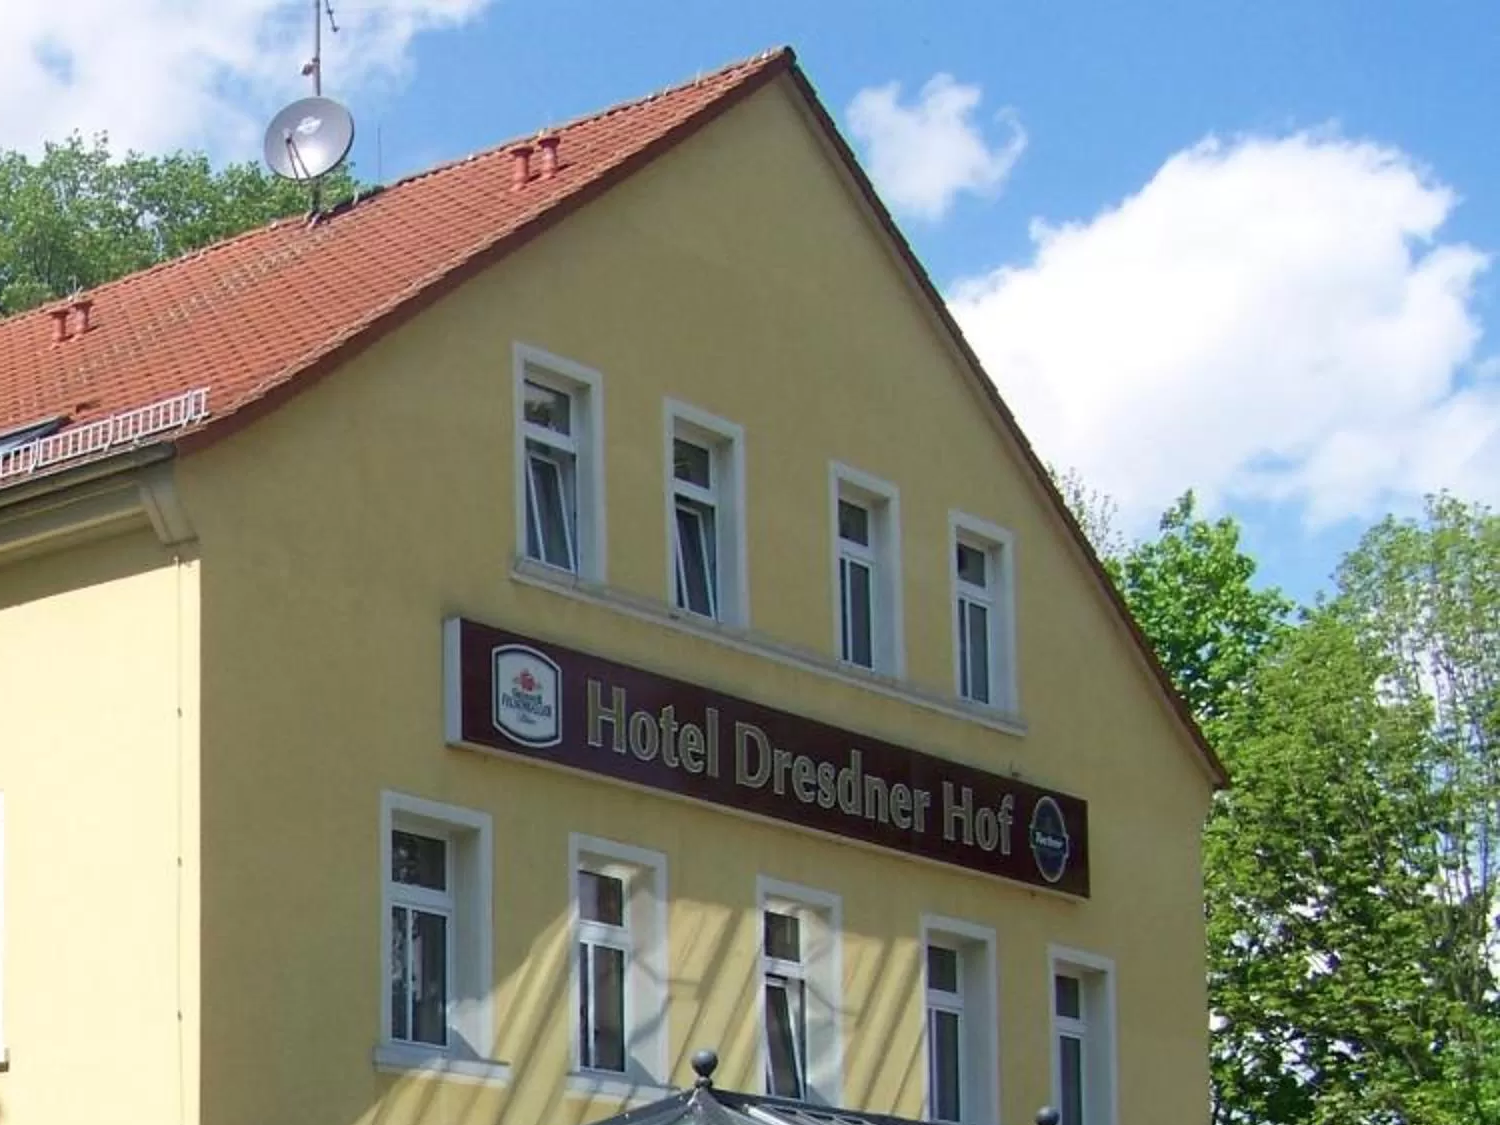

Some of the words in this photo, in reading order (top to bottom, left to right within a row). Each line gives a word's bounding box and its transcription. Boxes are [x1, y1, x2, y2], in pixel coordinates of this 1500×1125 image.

[587, 679, 719, 779] Hotel
[735, 720, 931, 834] Dresdner
[943, 780, 1015, 856] Hof
